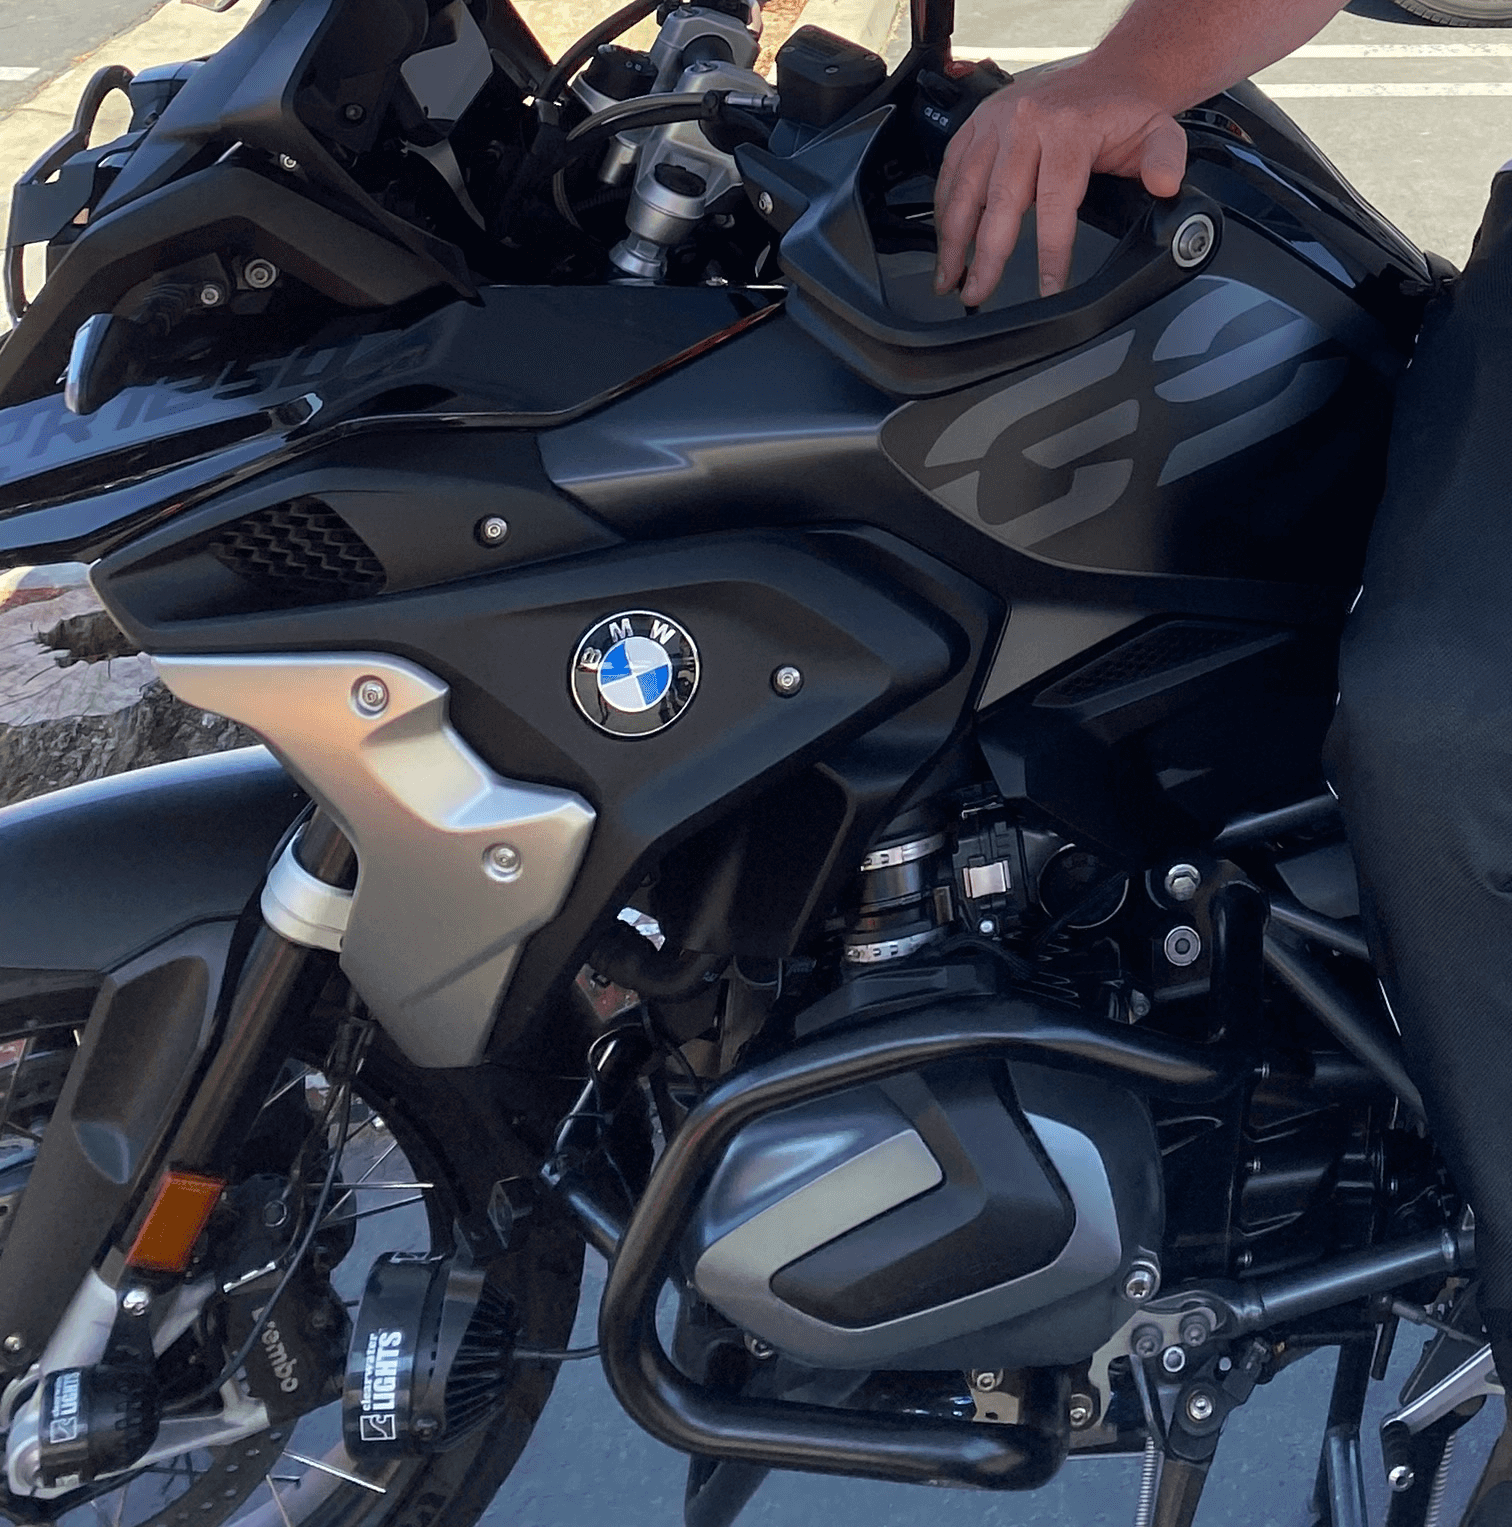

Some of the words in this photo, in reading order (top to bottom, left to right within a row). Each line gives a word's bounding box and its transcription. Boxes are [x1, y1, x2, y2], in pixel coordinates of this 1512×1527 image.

[580, 617, 676, 671] BMW
[361, 1332, 378, 1411] clearwater
[372, 1331, 402, 1410] LIGHTS
